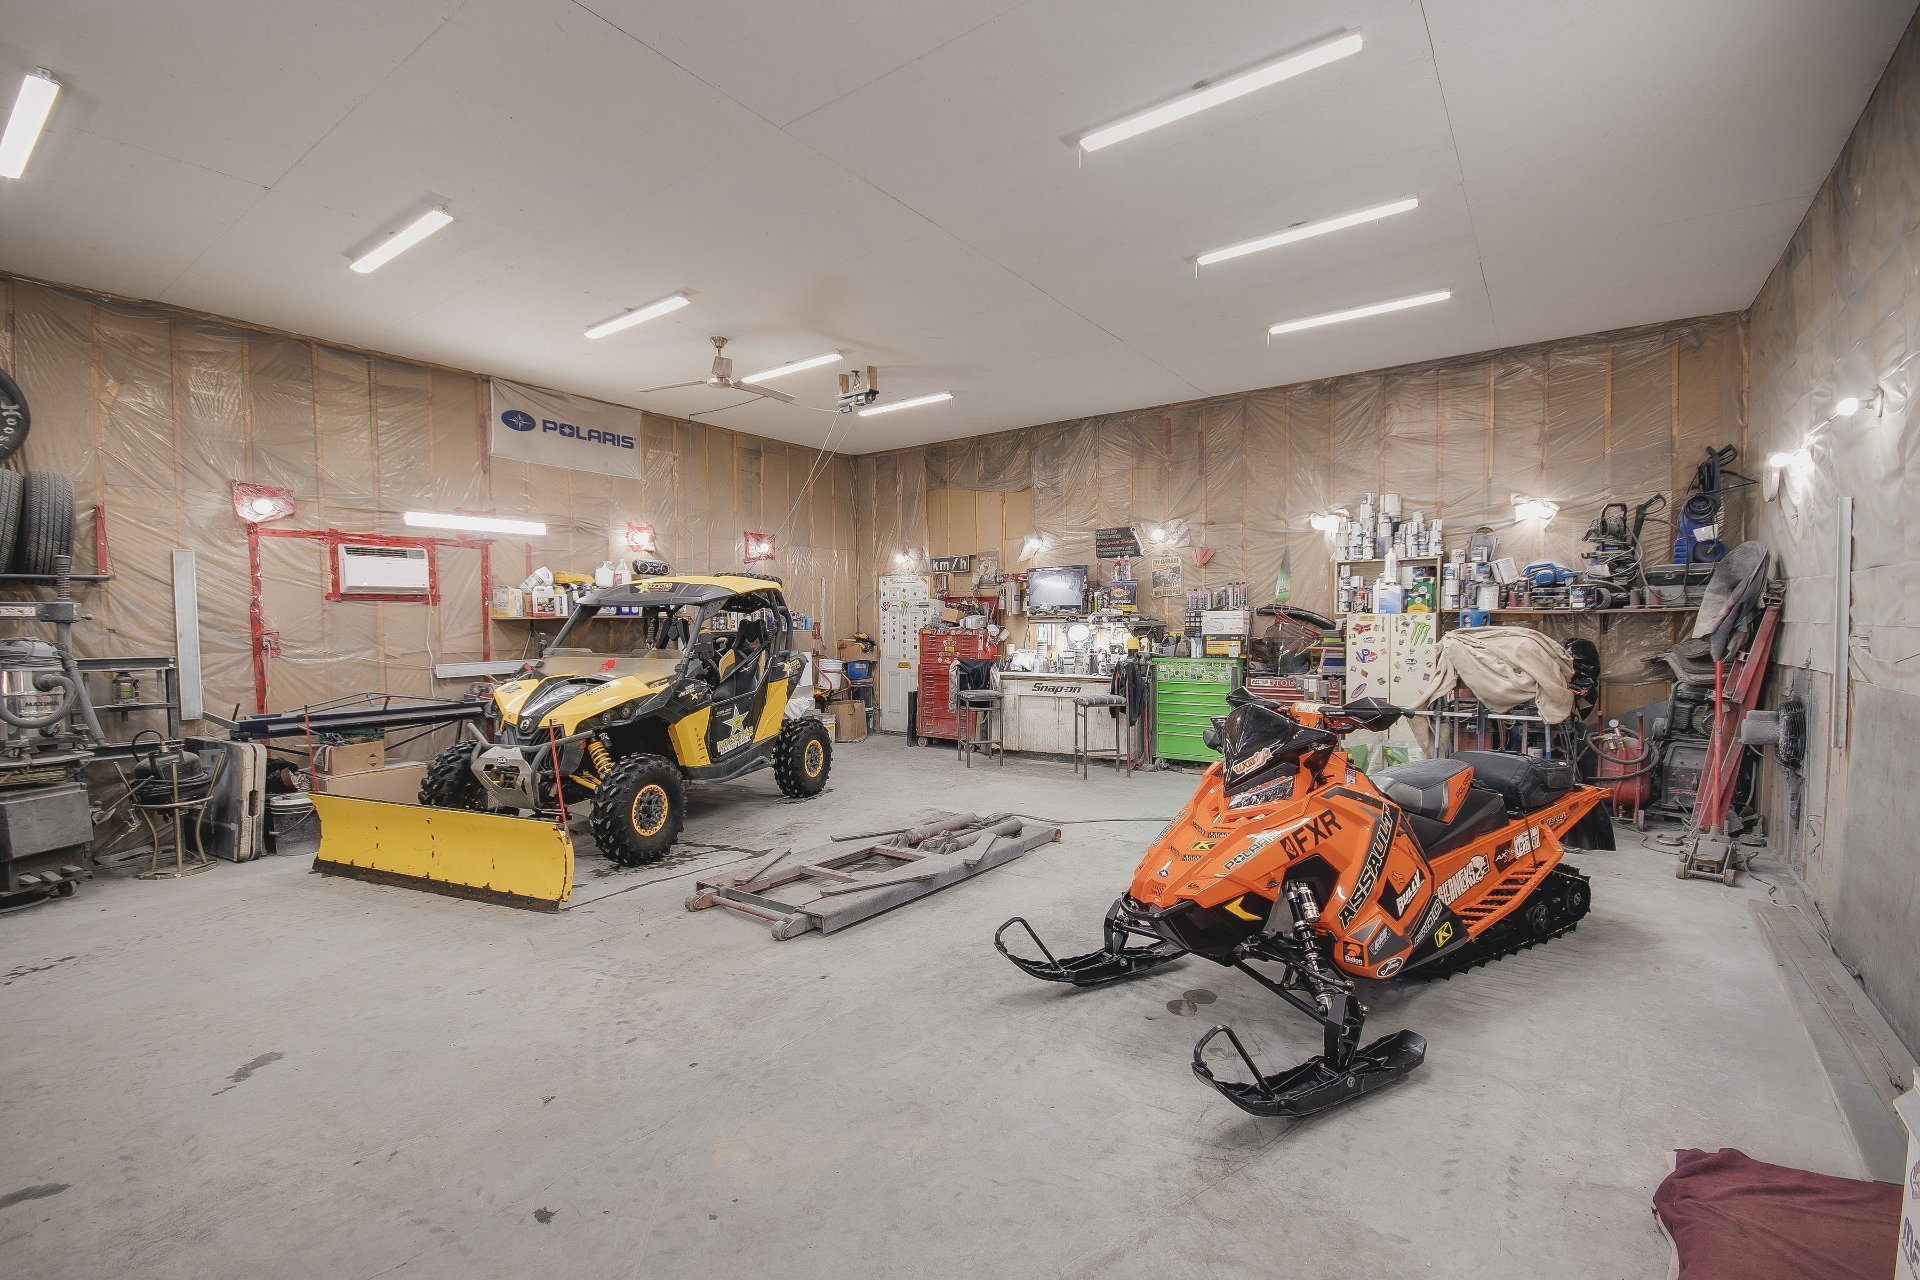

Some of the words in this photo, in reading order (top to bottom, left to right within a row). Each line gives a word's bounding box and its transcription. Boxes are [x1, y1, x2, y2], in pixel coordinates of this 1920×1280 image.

[542, 419, 635, 449] POLARIS
[932, 557, 967, 571] km/h
[1031, 682, 1082, 694] Snap-on
[1223, 829, 1284, 871] POLARIS
[1292, 809, 1342, 856] FXR
[1337, 802, 1396, 930] ASSAULT
[1396, 868, 1425, 917] BULLY
